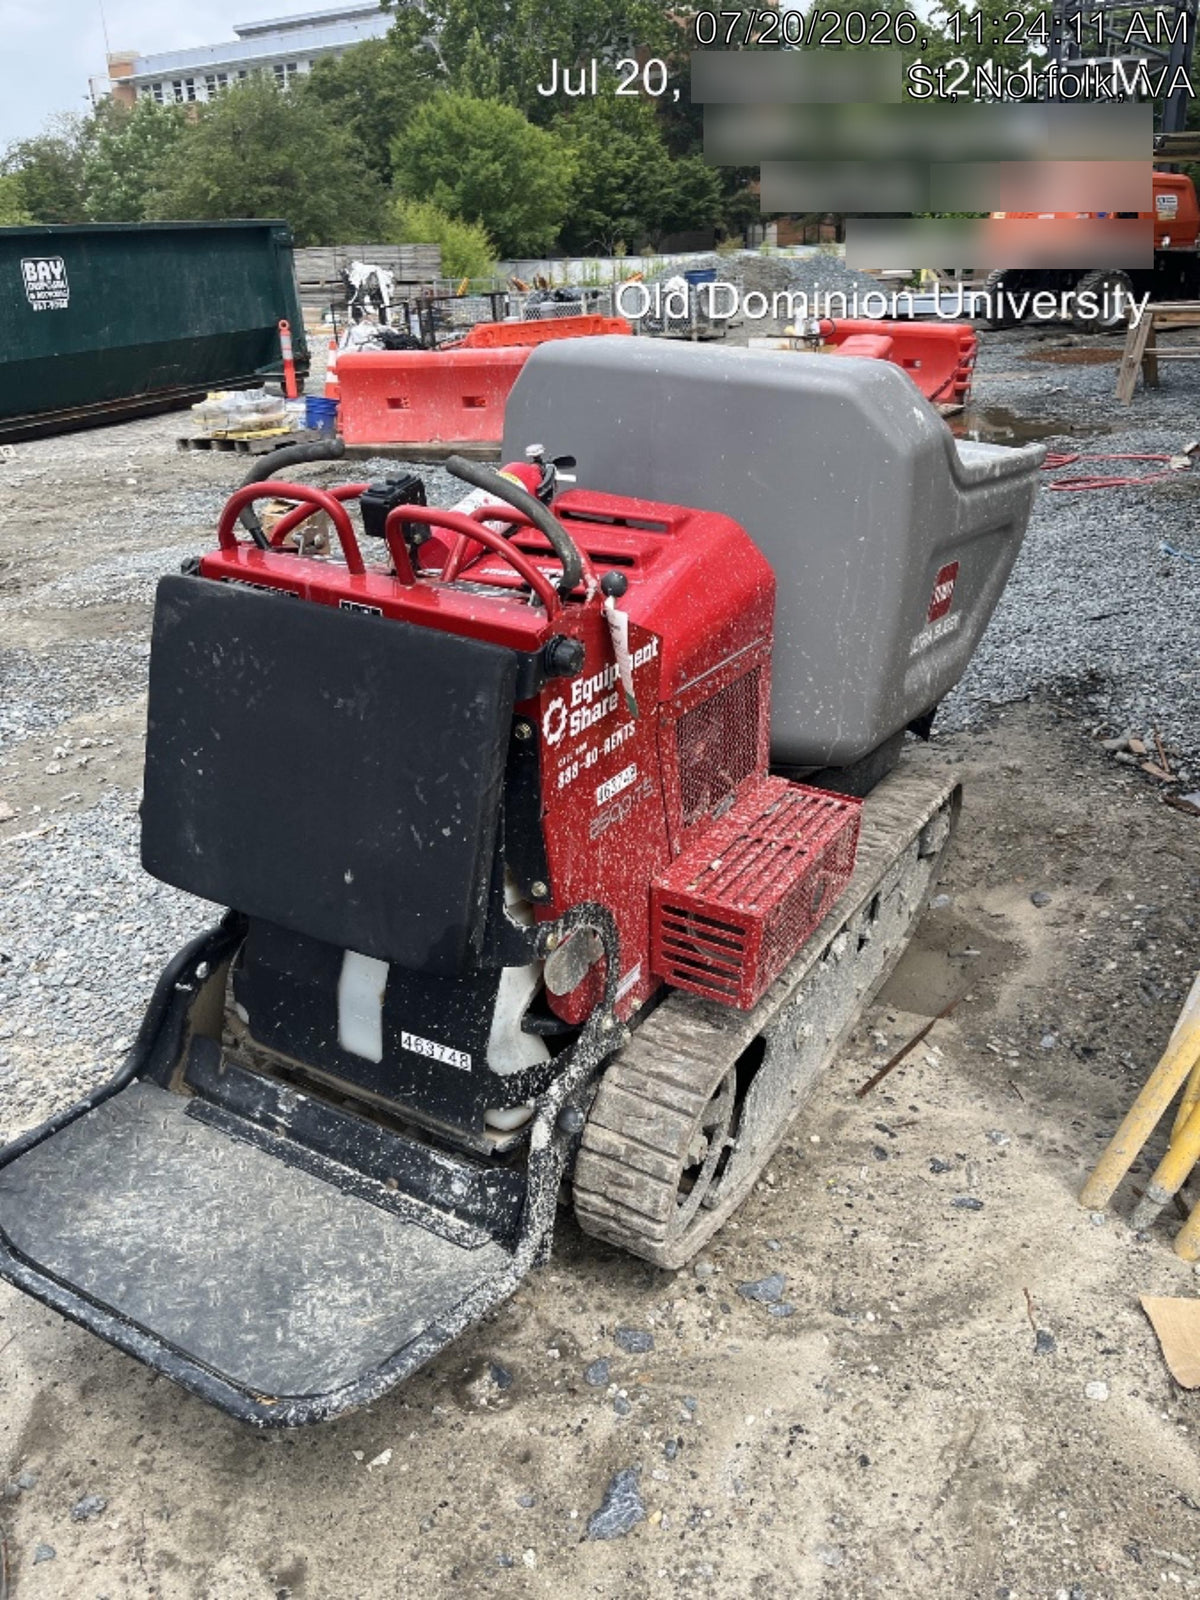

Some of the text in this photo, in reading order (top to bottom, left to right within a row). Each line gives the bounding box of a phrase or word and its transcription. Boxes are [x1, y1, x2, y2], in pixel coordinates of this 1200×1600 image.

[24, 261, 62, 281] BAY
[570, 635, 659, 708] Equipent
[569, 691, 619, 737] Share
[402, 1035, 469, 1069] 463748
